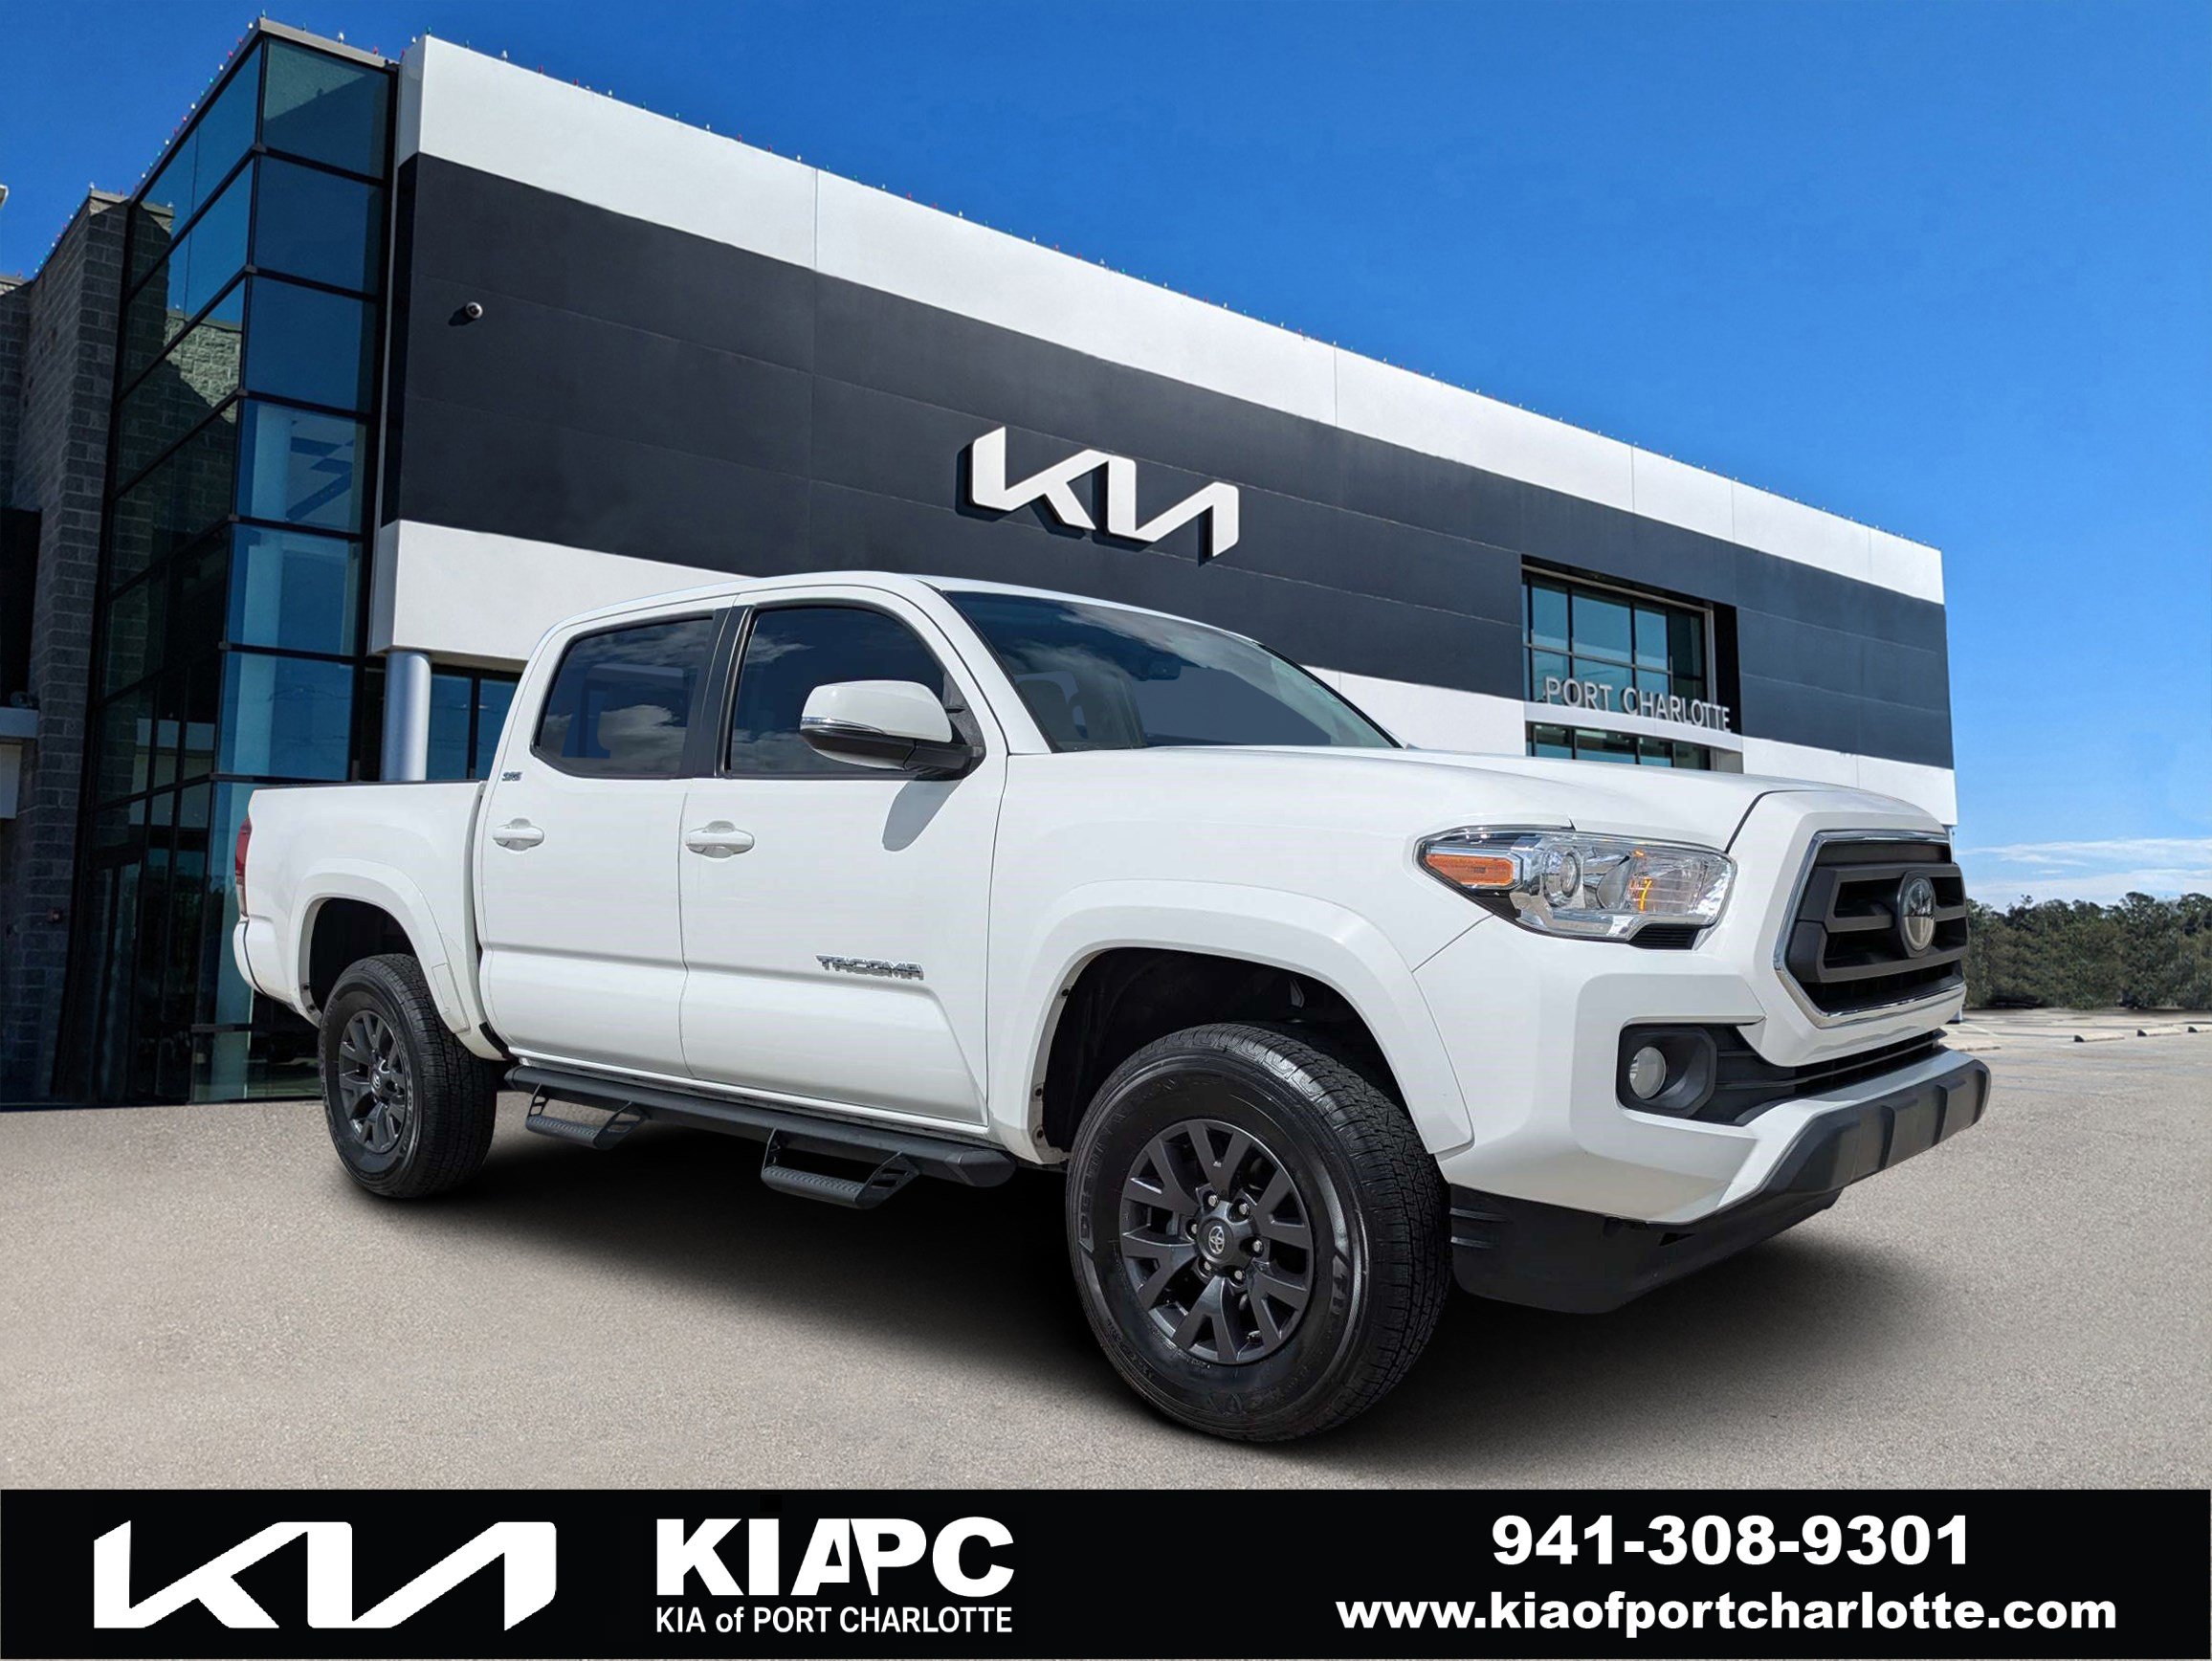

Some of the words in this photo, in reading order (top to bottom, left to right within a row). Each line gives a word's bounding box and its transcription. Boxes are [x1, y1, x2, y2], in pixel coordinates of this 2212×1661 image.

[1545, 675, 1613, 712] PORT
[1622, 687, 1732, 733] CHARLOTTE
[815, 954, 925, 981] TACOMA
